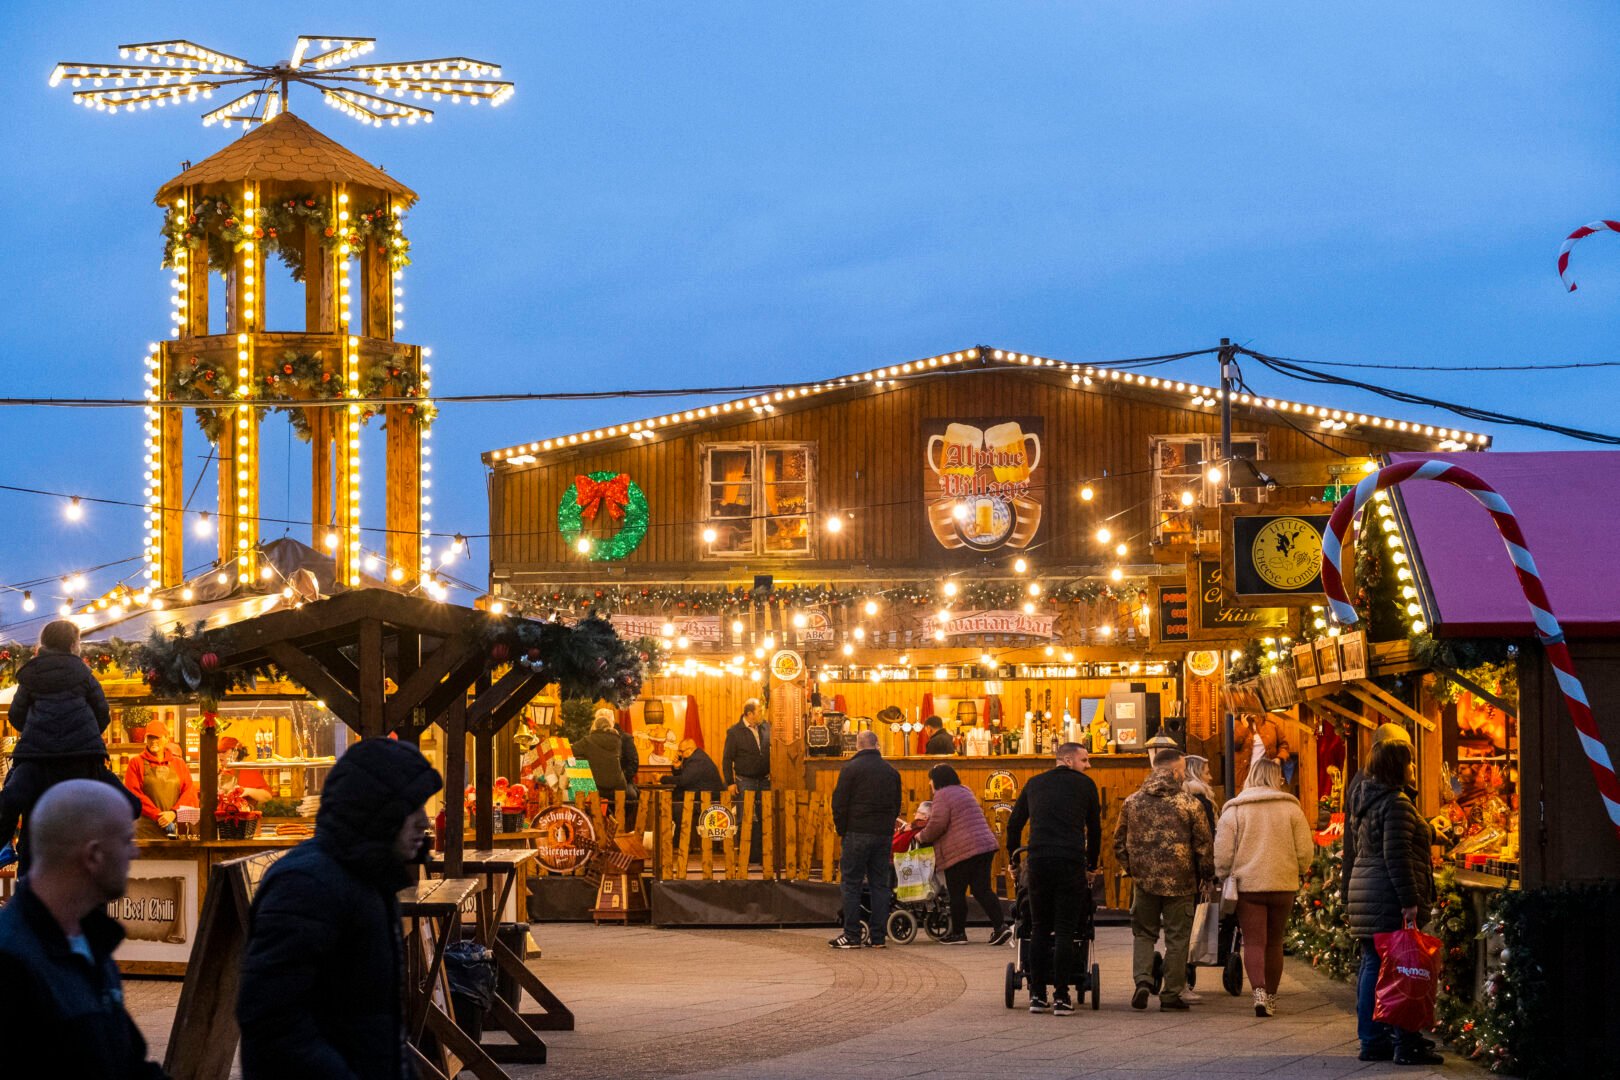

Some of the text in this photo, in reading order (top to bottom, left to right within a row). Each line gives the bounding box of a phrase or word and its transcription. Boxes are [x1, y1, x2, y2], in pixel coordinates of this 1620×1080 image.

[944, 443, 1025, 472] Alpine
[940, 474, 1030, 503] Village
[682, 620, 716, 637] Bar
[1014, 616, 1051, 634] Bar
[806, 630, 825, 640] ABK
[707, 828, 727, 838] ABK
[538, 846, 585, 857] Biergarten
[123, 897, 145, 921] Beef
[147, 897, 174, 923] Chilli
